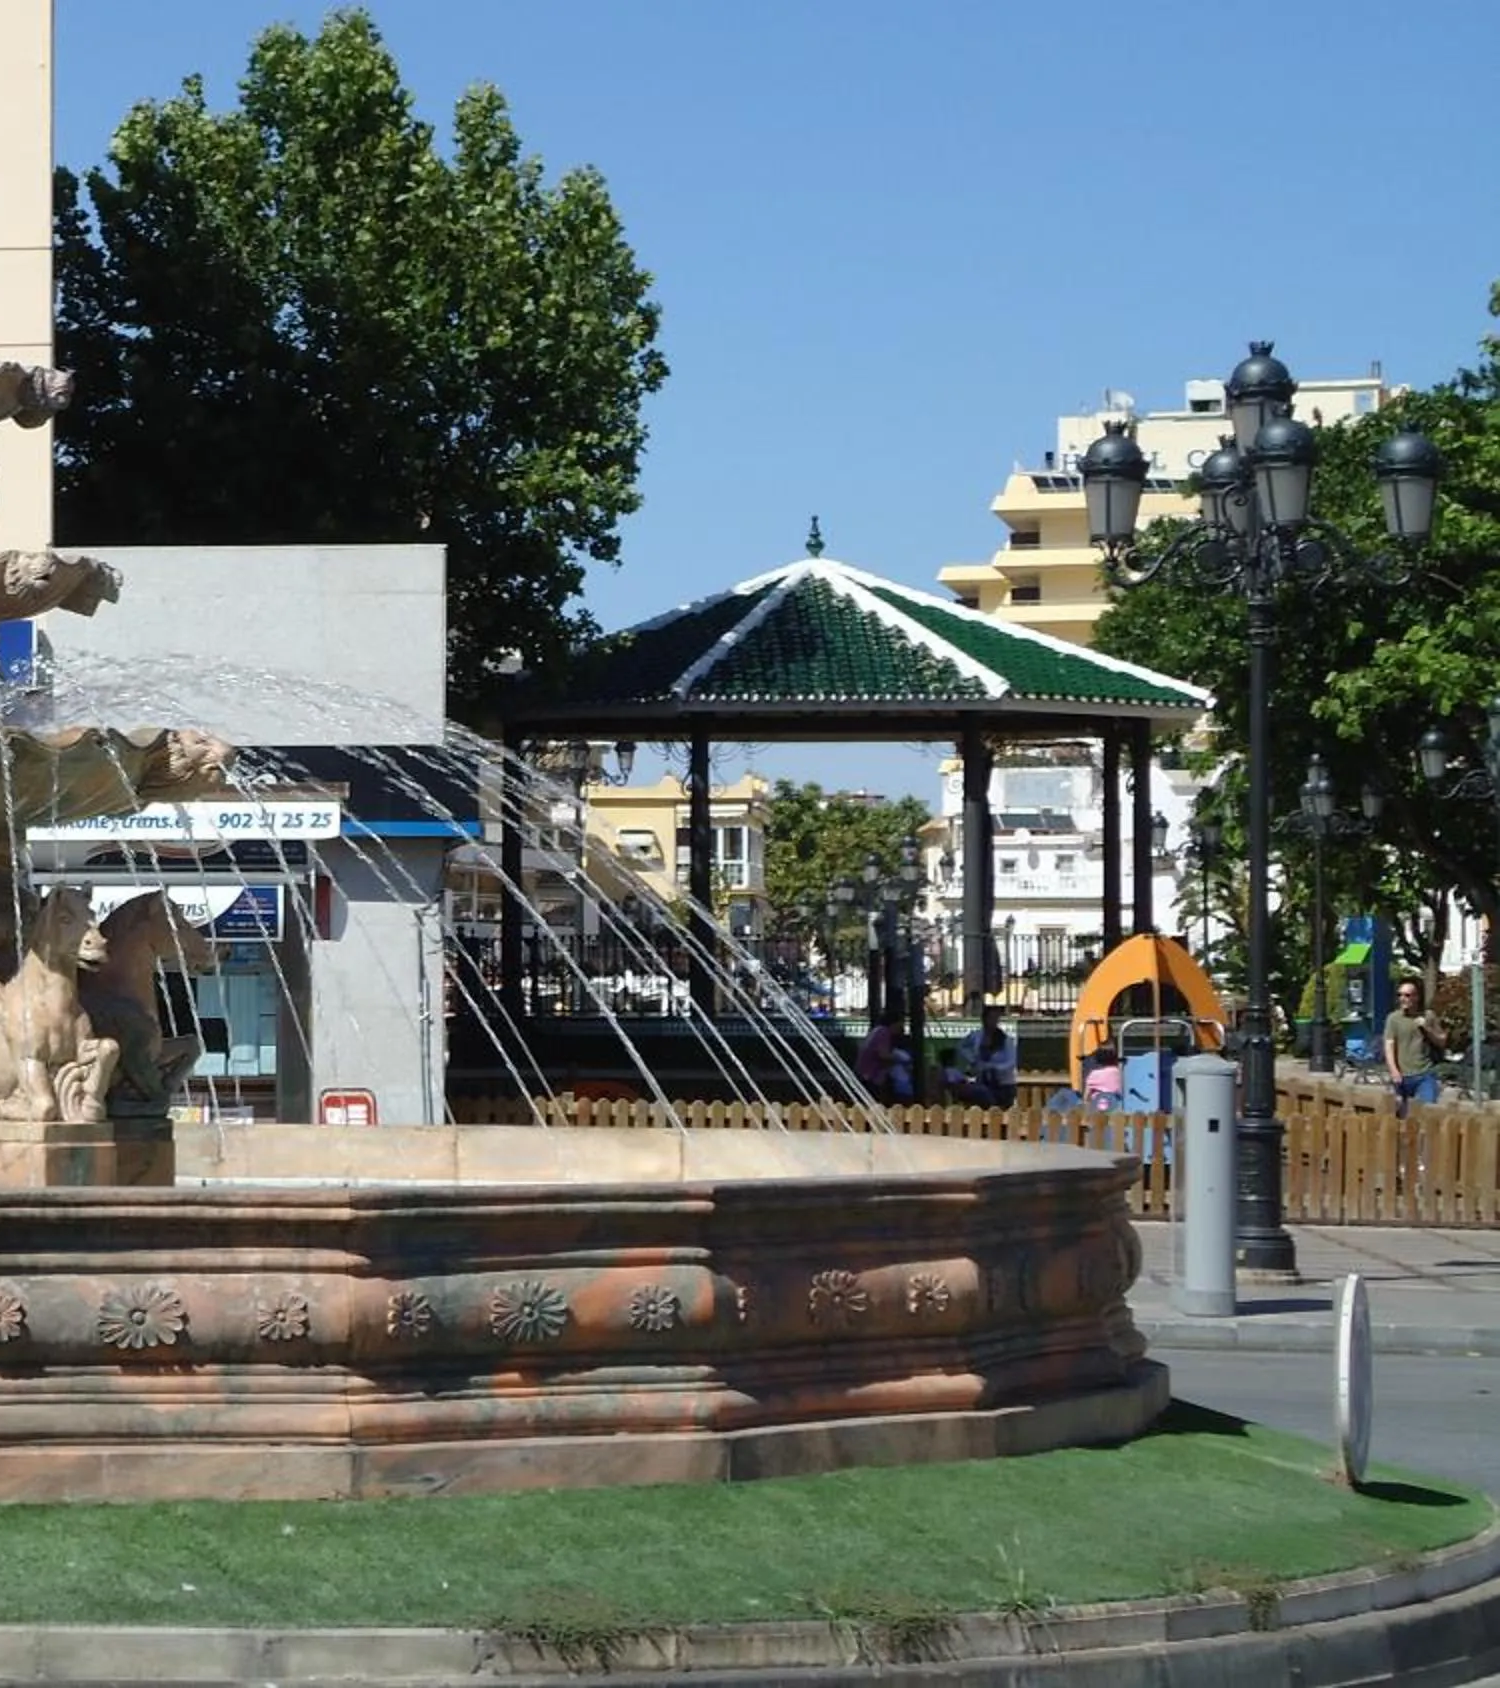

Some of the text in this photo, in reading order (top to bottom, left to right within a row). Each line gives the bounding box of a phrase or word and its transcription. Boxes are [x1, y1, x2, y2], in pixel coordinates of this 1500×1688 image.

[218, 812, 252, 829] 902
[281, 812, 304, 829] 25
[310, 812, 333, 829] 25
